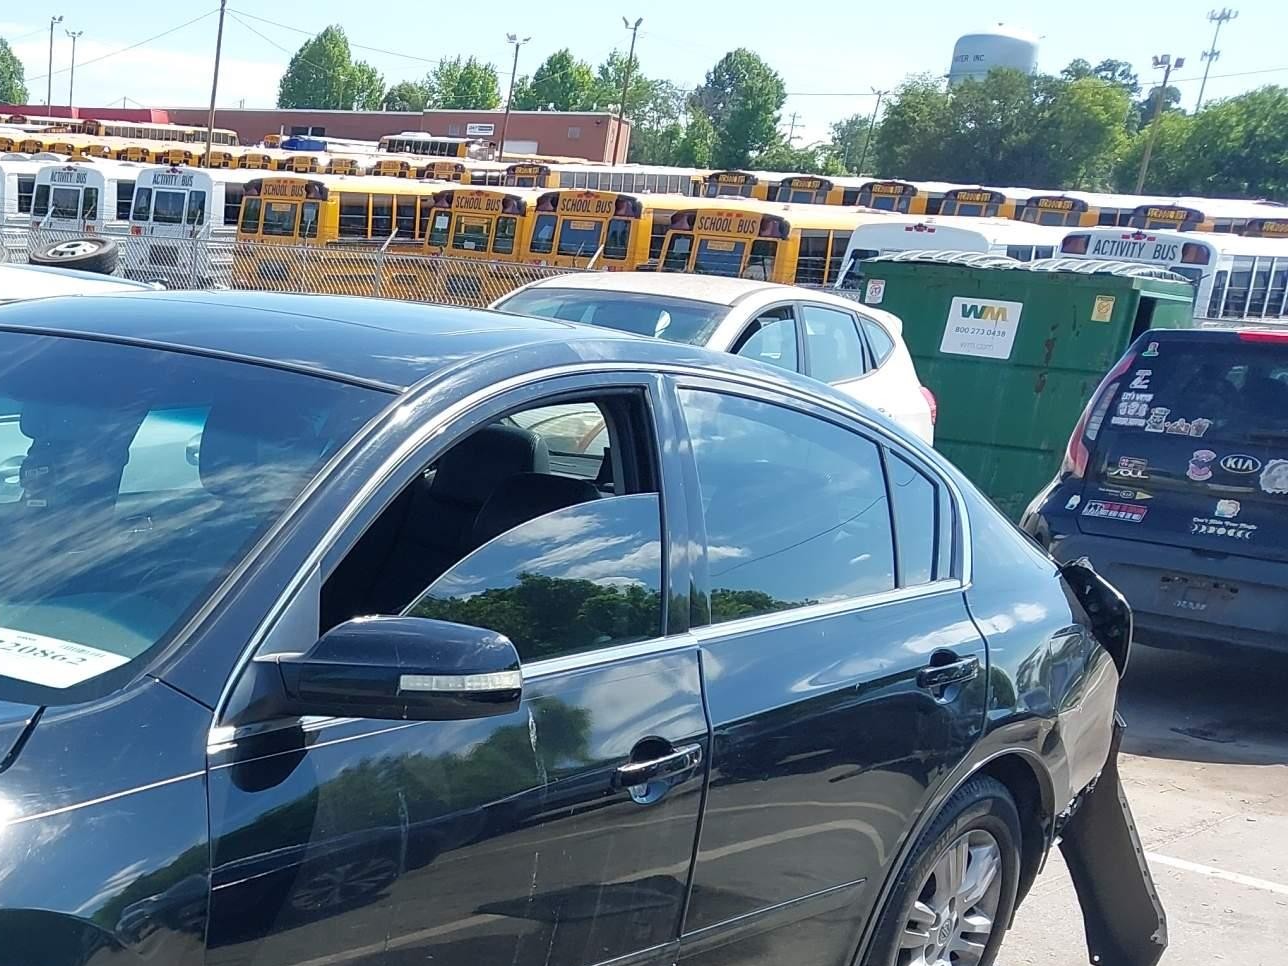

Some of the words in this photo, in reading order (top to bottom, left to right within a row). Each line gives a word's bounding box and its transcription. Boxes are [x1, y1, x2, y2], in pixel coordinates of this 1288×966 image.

[76, 173, 87, 184] BUS
[152, 173, 178, 186] ACTIVITY
[181, 175, 194, 187] BUS
[263, 183, 288, 196] SCHOOL
[290, 184, 305, 197] BUS
[455, 196, 483, 210] SCHOOL
[485, 198, 501, 212] BUS
[560, 198, 591, 213] SCHOOL
[595, 200, 613, 214] BUS
[697, 215, 732, 233] SCHOOL
[737, 218, 757, 234] BUS
[1092, 239, 1146, 257] ACTIVITY
[1152, 243, 1179, 261] BUS
[961, 303, 1007, 322] WM
[955, 326, 970, 334] 800
[1226, 457, 1253, 471] KIA
